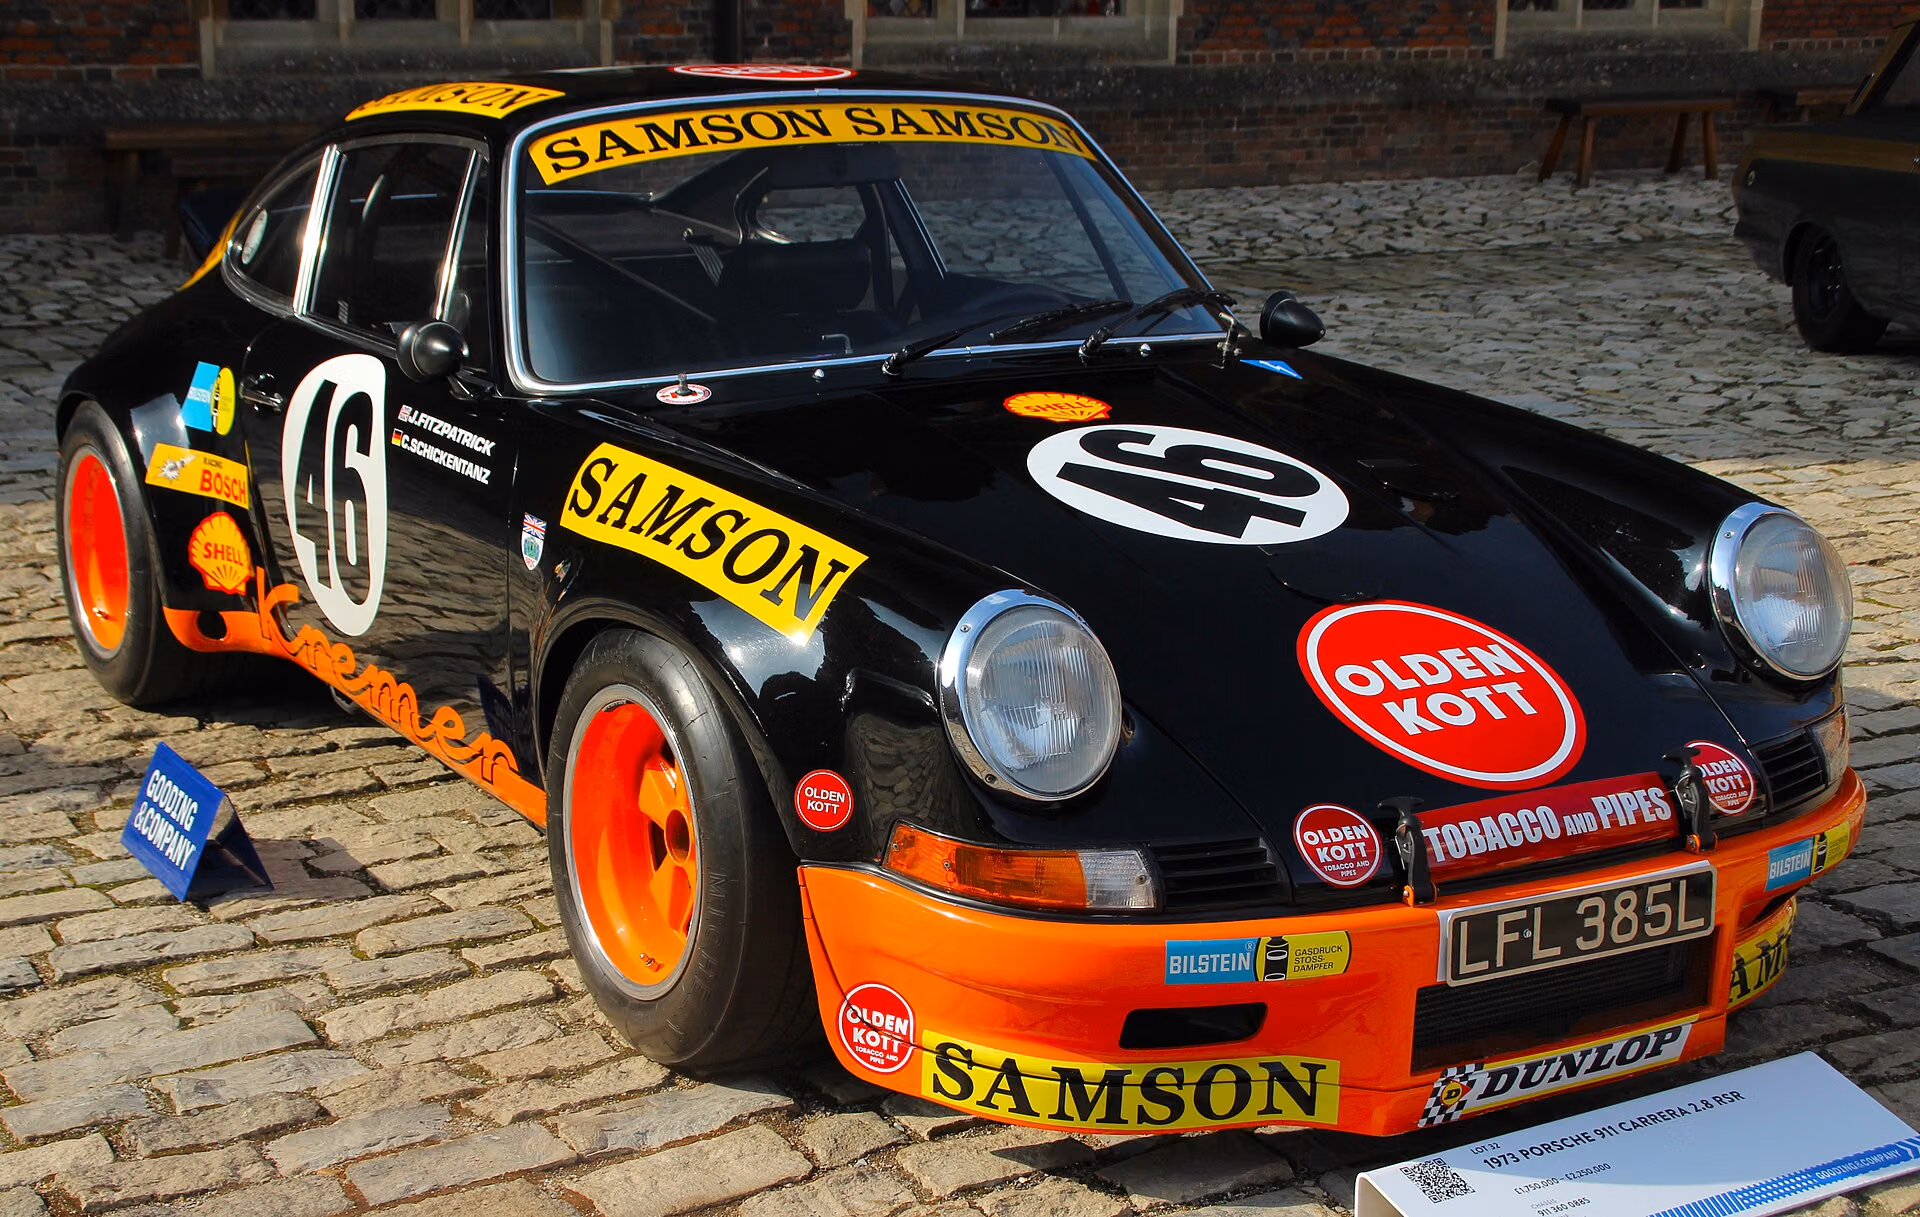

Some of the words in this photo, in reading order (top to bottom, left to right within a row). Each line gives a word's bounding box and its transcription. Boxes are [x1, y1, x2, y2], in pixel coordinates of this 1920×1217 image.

[544, 109, 832, 174] SAMSON
[844, 107, 1084, 153] SAMSON
[1023, 402, 1094, 412] SHELL
[408, 405, 496, 457] J.FITZPATRICK
[400, 433, 492, 485] C.SCHICKENTANZ
[199, 468, 247, 505] BOSCH
[294, 379, 374, 606] 46
[1056, 429, 1321, 539] 46
[203, 541, 244, 567] SHELL
[568, 456, 850, 622] SAMSON
[1334, 643, 1526, 697] OLDEN
[1382, 681, 1538, 736] KOTT
[146, 769, 199, 832] GOODING
[804, 786, 846, 803] OLDEN
[1705, 774, 1745, 794] KOTT
[807, 799, 840, 814] KOTT
[133, 801, 197, 871] &COMPANY
[1303, 824, 1370, 846] OLDEN
[1424, 805, 1562, 863] TOBACCO
[1563, 811, 1599, 837] AND
[1591, 786, 1673, 830] PIPES
[1316, 841, 1367, 863] KOTT
[1324, 863, 1354, 872] TOBACCO
[1769, 847, 1812, 880] BILSTEIN
[1459, 907, 1562, 975] LFL
[1576, 879, 1705, 951] 385L
[1168, 952, 1251, 975] BILSTEIN
[1294, 944, 1344, 957] GASDRUCK
[1294, 954, 1326, 965] STOSS-
[846, 1004, 909, 1036] OLDEN
[852, 1027, 904, 1054] KOTT
[855, 1045, 885, 1058] TOBACCO
[885, 1052, 899, 1062] AND
[1477, 1024, 1684, 1101] DUNLOP
[932, 1041, 1328, 1126] SAMSON
[1483, 1152, 1521, 1169] 1973
[1518, 1131, 1596, 1160] PORSCHE
[1593, 1125, 1620, 1139] 911
[1618, 1106, 1692, 1132] CARRERA
[1687, 1099, 1714, 1113] 2.8
[1711, 1090, 1745, 1106] RSR
[1470, 1145, 1488, 1155] LOT
[1488, 1142, 1501, 1150] 32
[1514, 1177, 1560, 1195] £1,750,000
[1564, 1162, 1612, 1181] £2,250,000
[1537, 1207, 1553, 1216] 911
[1551, 1203, 1569, 1213] 360
[1567, 1196, 1591, 1208] 0885
